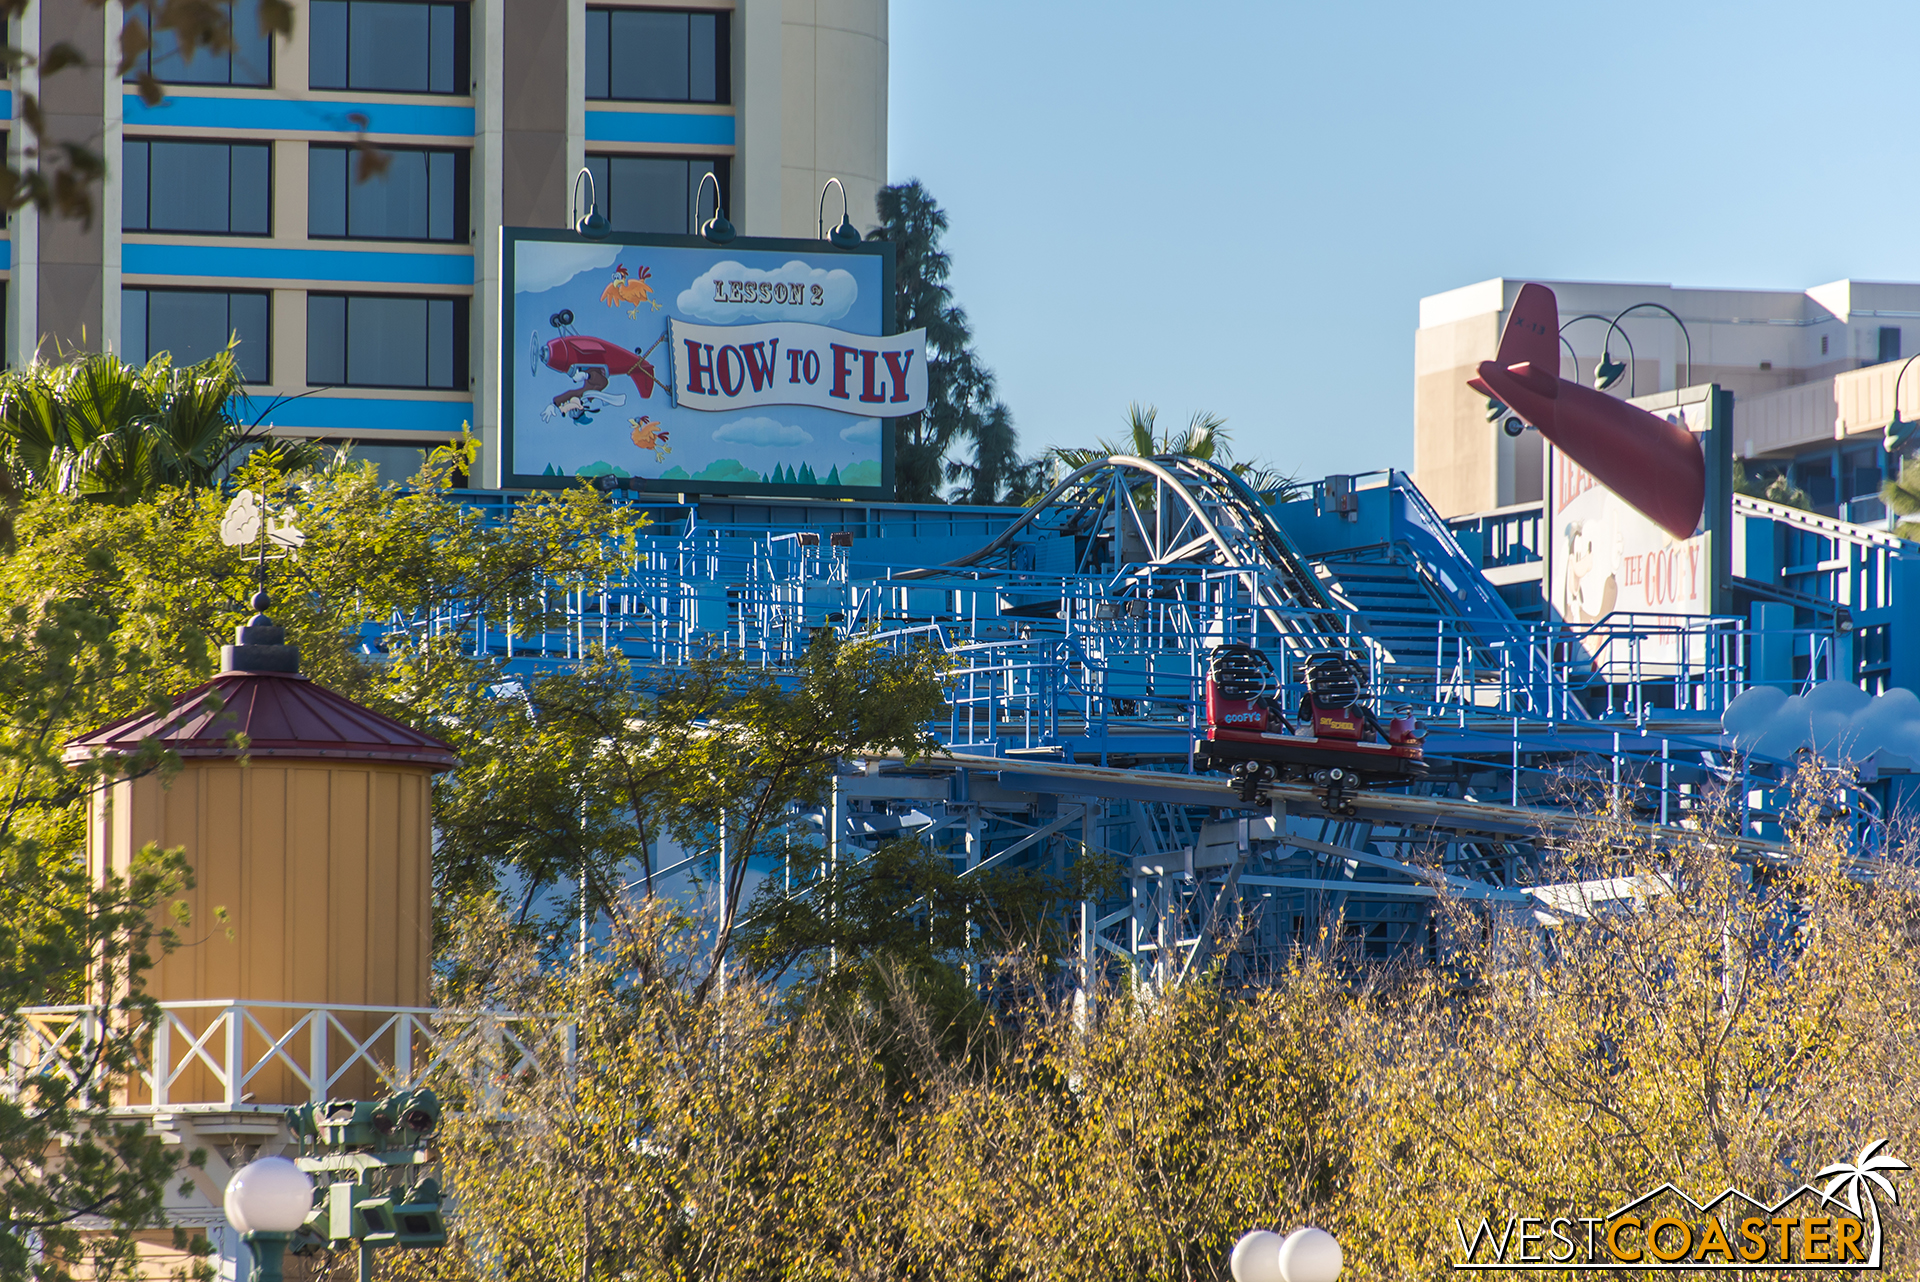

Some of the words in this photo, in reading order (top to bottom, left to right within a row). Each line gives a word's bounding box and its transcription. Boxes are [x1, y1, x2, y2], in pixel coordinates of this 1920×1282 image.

[713, 279, 805, 305] LESSON
[810, 283, 824, 306] 2
[684, 338, 779, 397] HOW
[787, 349, 820, 385] TO
[829, 342, 914, 404] FLY
[1624, 554, 1643, 587] THE
[1225, 711, 1261, 724] GOOFY'S
[1331, 721, 1355, 730] SCHOOL
